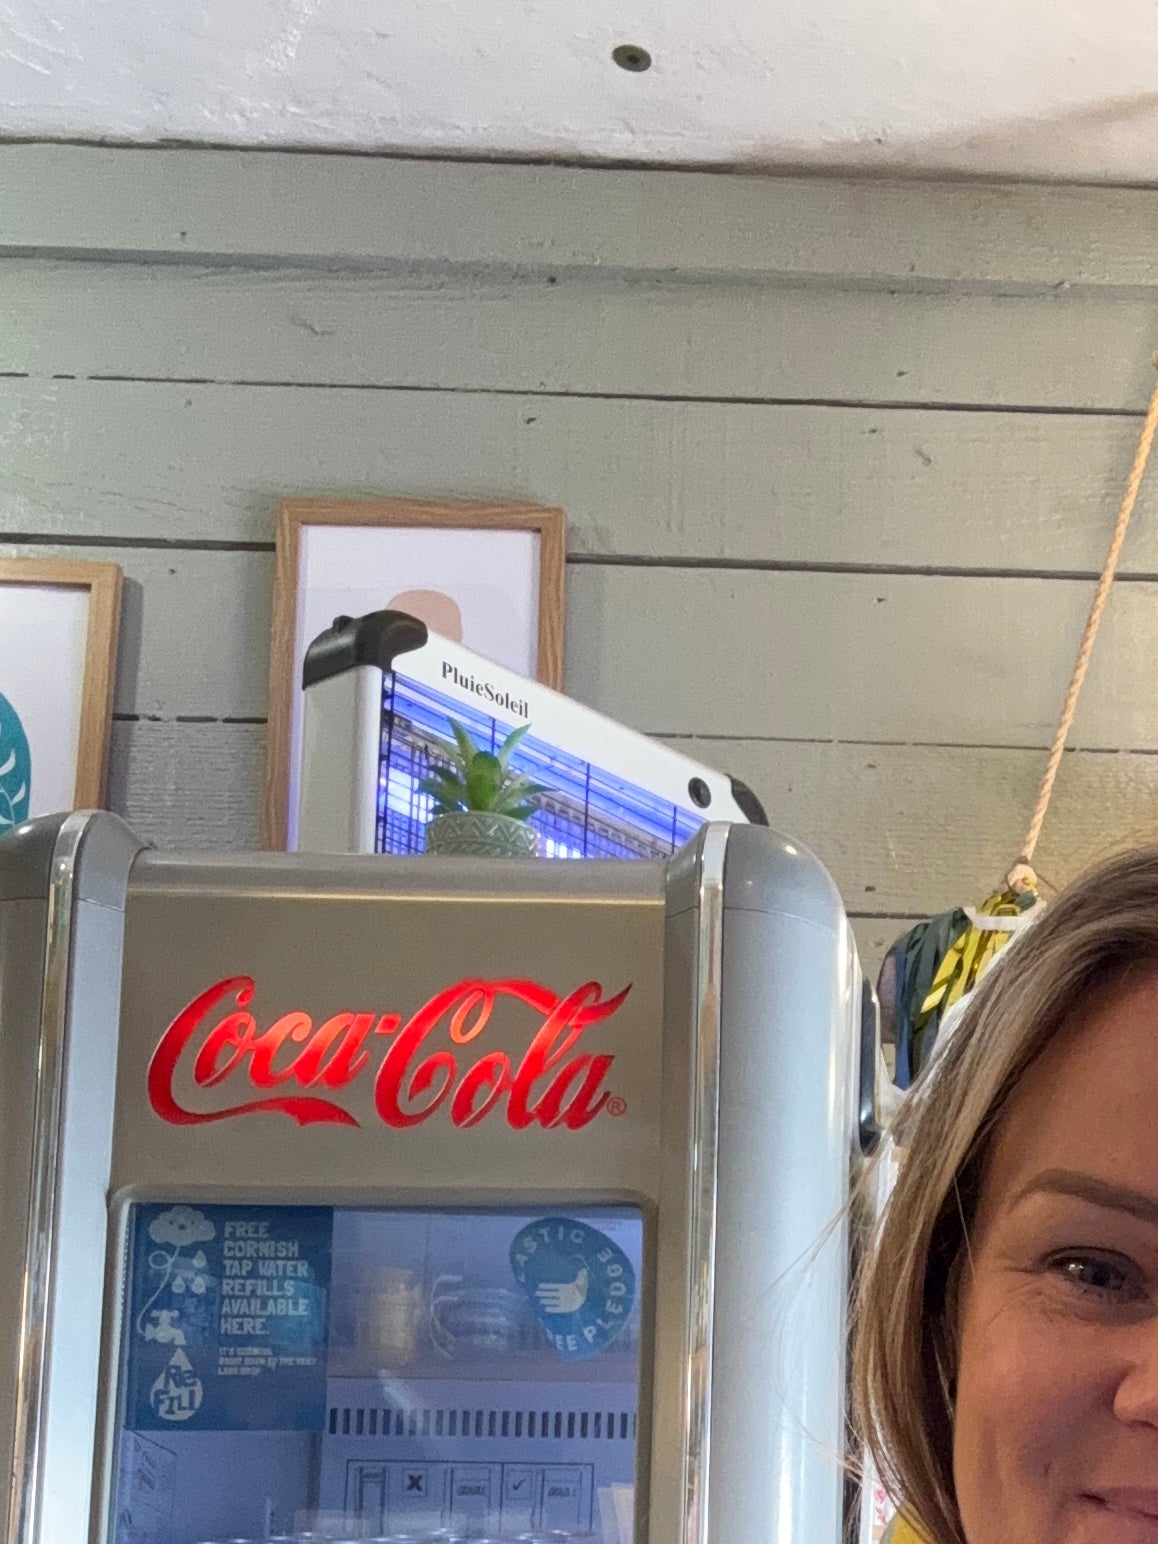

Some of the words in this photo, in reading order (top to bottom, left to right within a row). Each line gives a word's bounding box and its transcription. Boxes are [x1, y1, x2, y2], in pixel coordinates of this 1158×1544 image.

[442, 661, 528, 718] PluieSoleil
[224, 1221, 270, 1238] FREE
[223, 1240, 300, 1257] CORNISH
[223, 1259, 251, 1277] TAP
[258, 1260, 309, 1277] WATER
[222, 1279, 295, 1296] REFILLS
[583, 1248, 626, 1344] PLEDGE
[221, 1299, 309, 1316] AVAILABLE
[220, 1318, 270, 1335] HERE.
